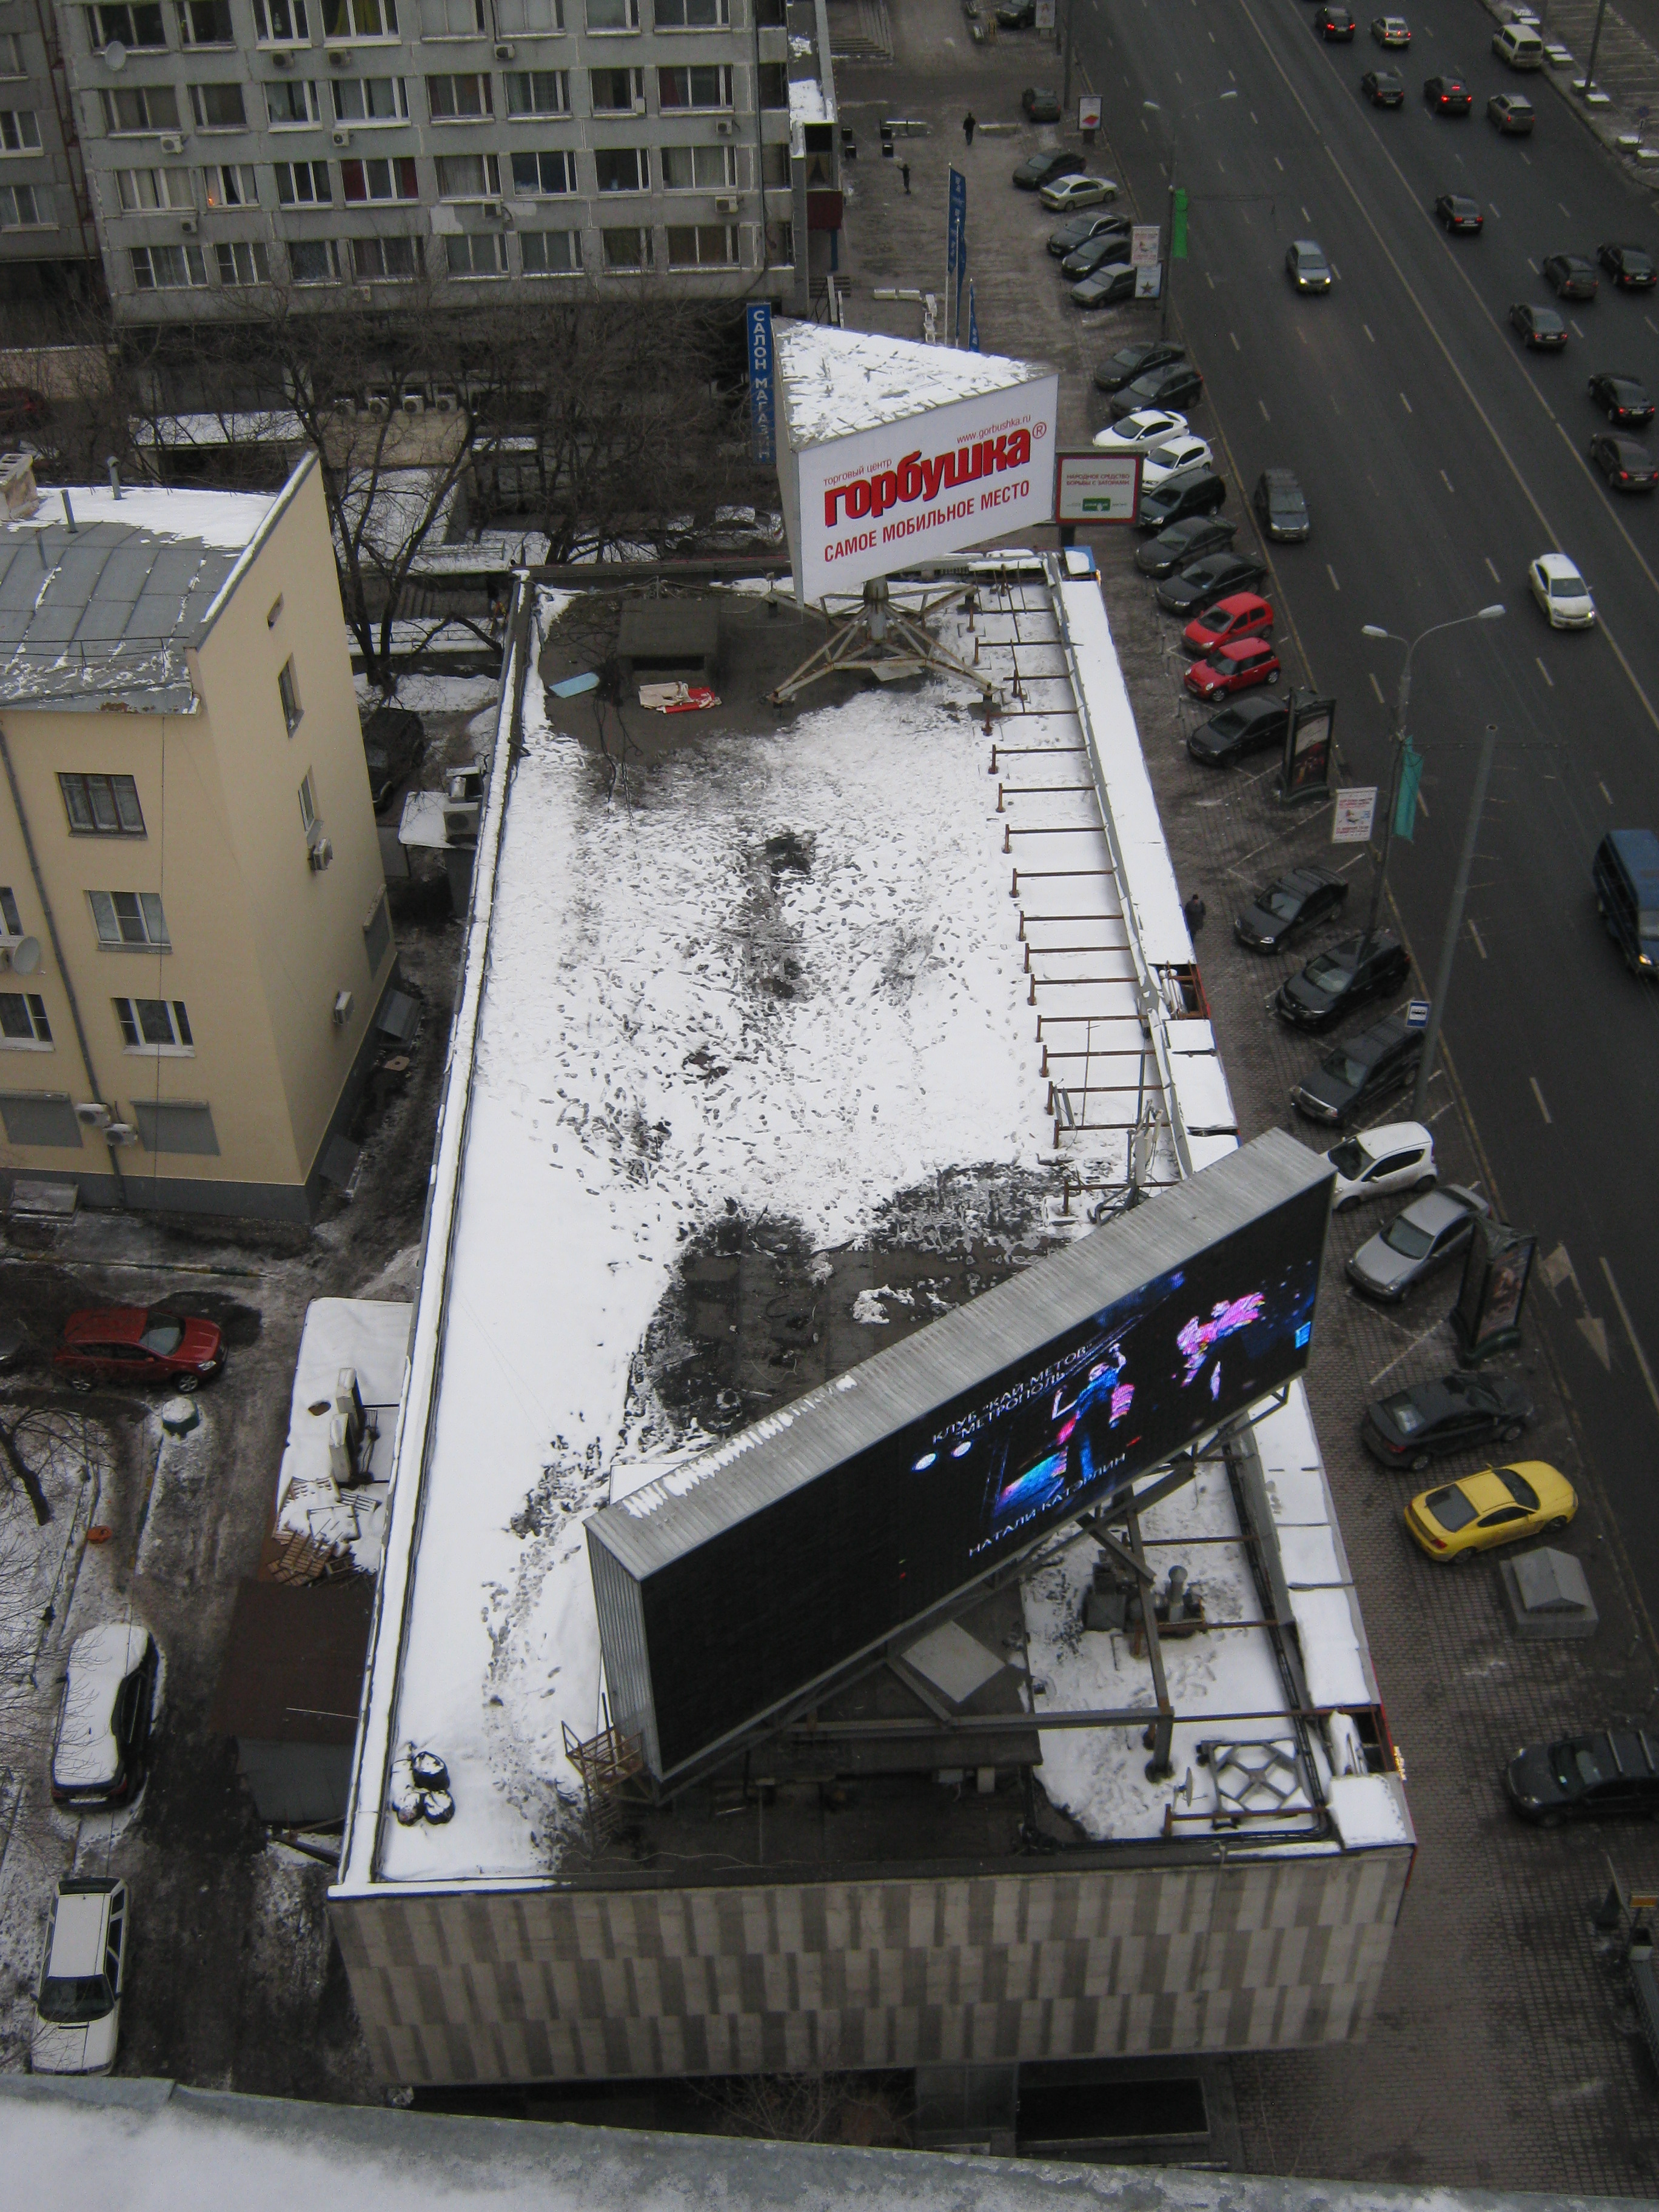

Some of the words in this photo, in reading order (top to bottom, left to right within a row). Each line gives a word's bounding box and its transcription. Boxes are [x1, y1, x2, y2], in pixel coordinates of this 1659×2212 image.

[753, 310, 767, 370] САЛОН
[957, 415, 1031, 443] www.gorbushka.ru
[823, 465, 864, 486] торговый
[867, 458, 892, 474] центр
[825, 530, 877, 563] САМОЕ
[882, 498, 975, 544] МОБИЛЬНОЕ
[980, 480, 1030, 511] МЕСТО
[932, 1410, 977, 1446] КЛУБ
[969, 1508, 1037, 1557] НАТАЛИ
